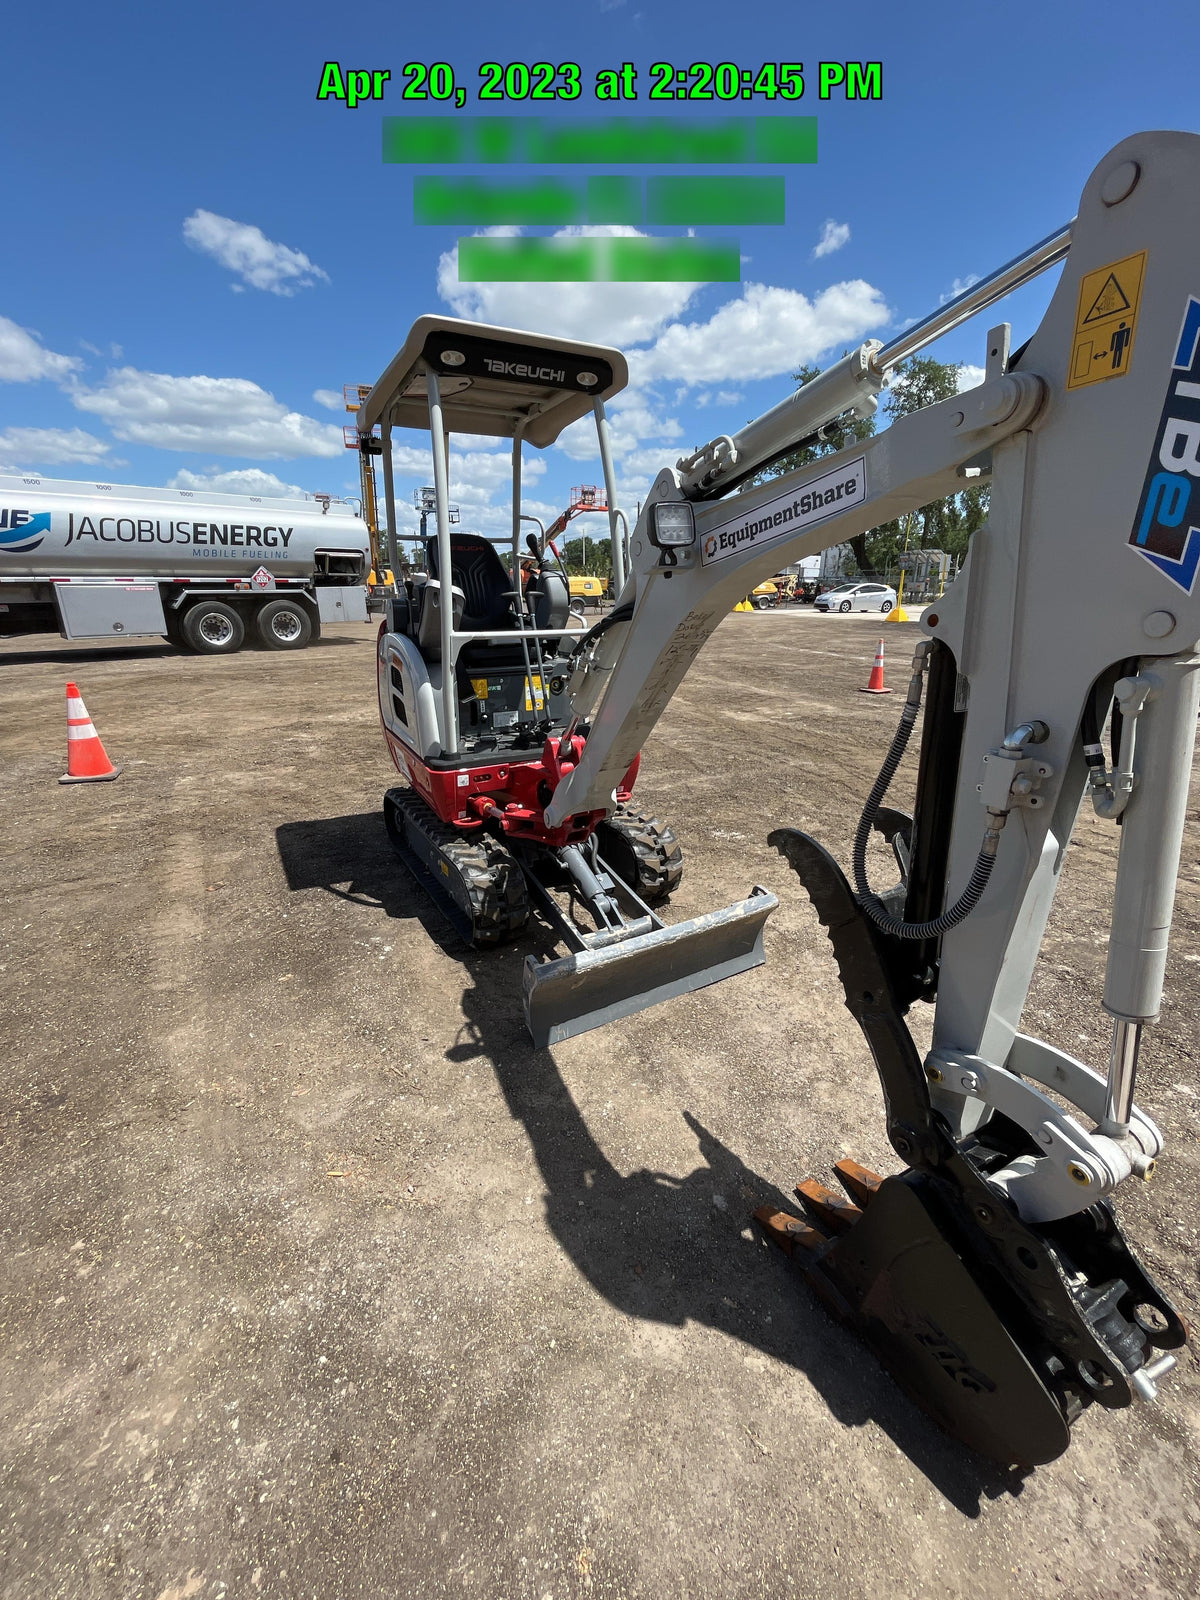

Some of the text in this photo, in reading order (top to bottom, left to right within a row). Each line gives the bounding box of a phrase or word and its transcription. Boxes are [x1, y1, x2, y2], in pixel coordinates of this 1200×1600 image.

[23, 478, 41, 486] 1500
[719, 478, 857, 550] EquipmentShare
[192, 548, 289, 560] MOBILE FUELING
